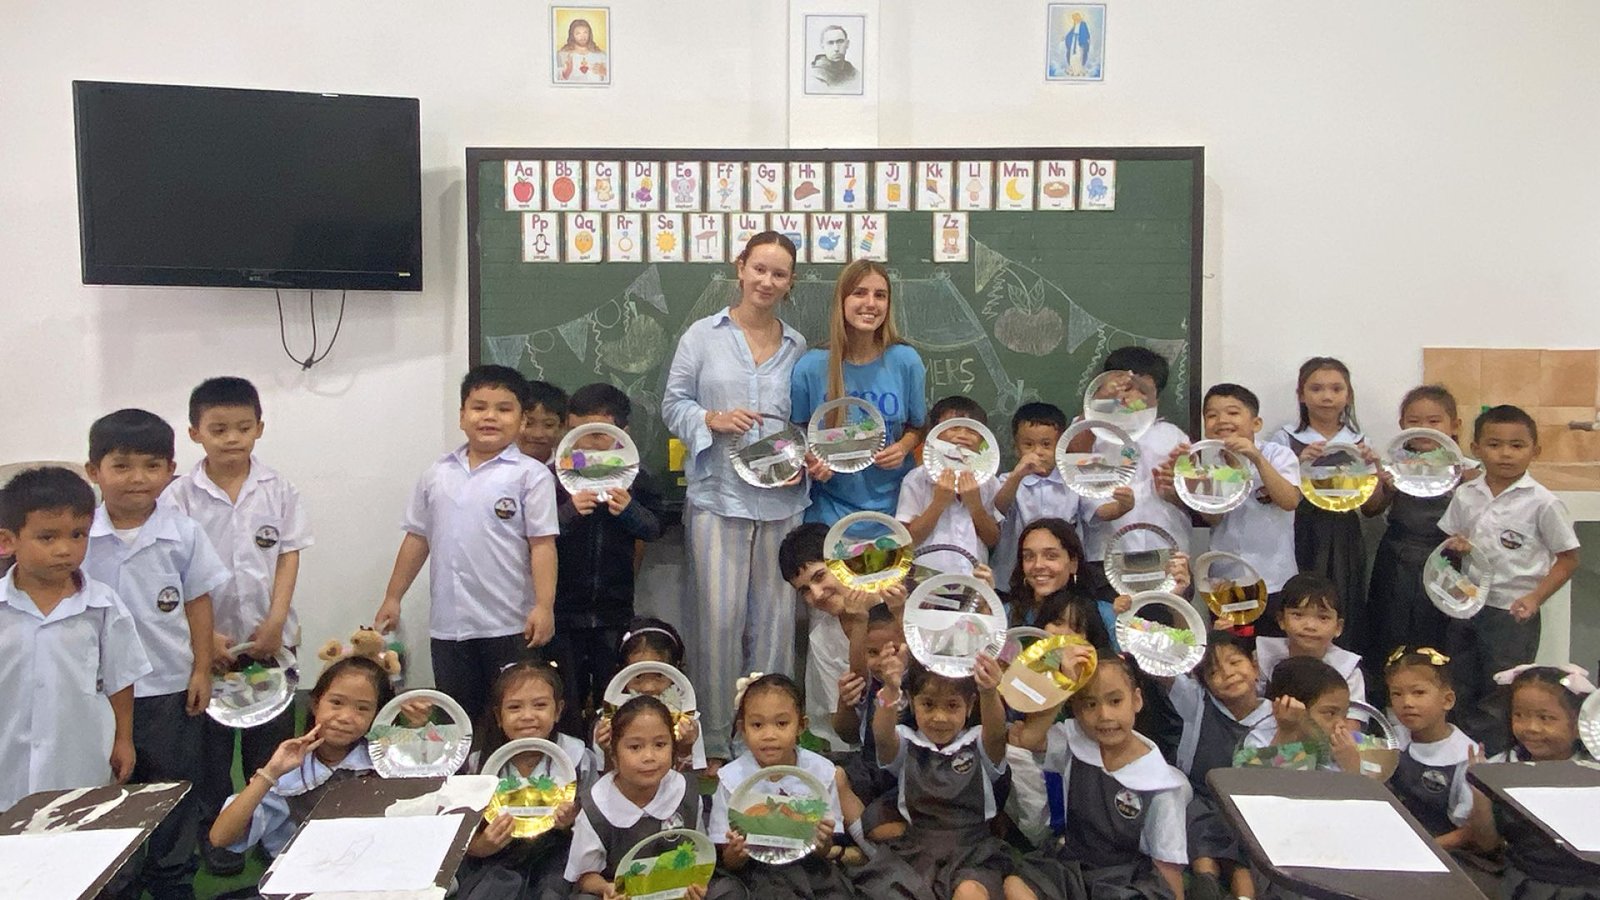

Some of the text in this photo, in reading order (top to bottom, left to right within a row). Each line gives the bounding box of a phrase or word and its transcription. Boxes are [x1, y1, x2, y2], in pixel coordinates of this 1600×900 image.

[515, 162, 533, 176] Aa
[555, 162, 572, 176] Bb
[596, 162, 612, 177] Cc
[635, 162, 651, 177] Dd
[676, 162, 692, 177] Ee
[717, 164, 734, 178] Ff
[758, 164, 775, 182] Gg
[799, 165, 815, 178] Hh
[845, 164, 855, 178] Ii
[886, 164, 900, 181] Jj
[927, 164, 942, 177] Kk
[970, 163, 980, 177] Ll
[1004, 163, 1028, 177] Mm
[1049, 163, 1065, 177] Nn
[1089, 162, 1106, 176] Oo
[532, 215, 548, 232] Pp
[575, 215, 595, 232] Qq
[618, 215, 633, 229] Rr
[658, 215, 673, 229] Ss
[699, 216, 715, 229] Tt
[739, 216, 756, 229] Uu
[780, 216, 797, 230] Vv
[816, 216, 842, 230] Ww
[862, 216, 877, 230] Xx
[943, 215, 959, 229] Zz
